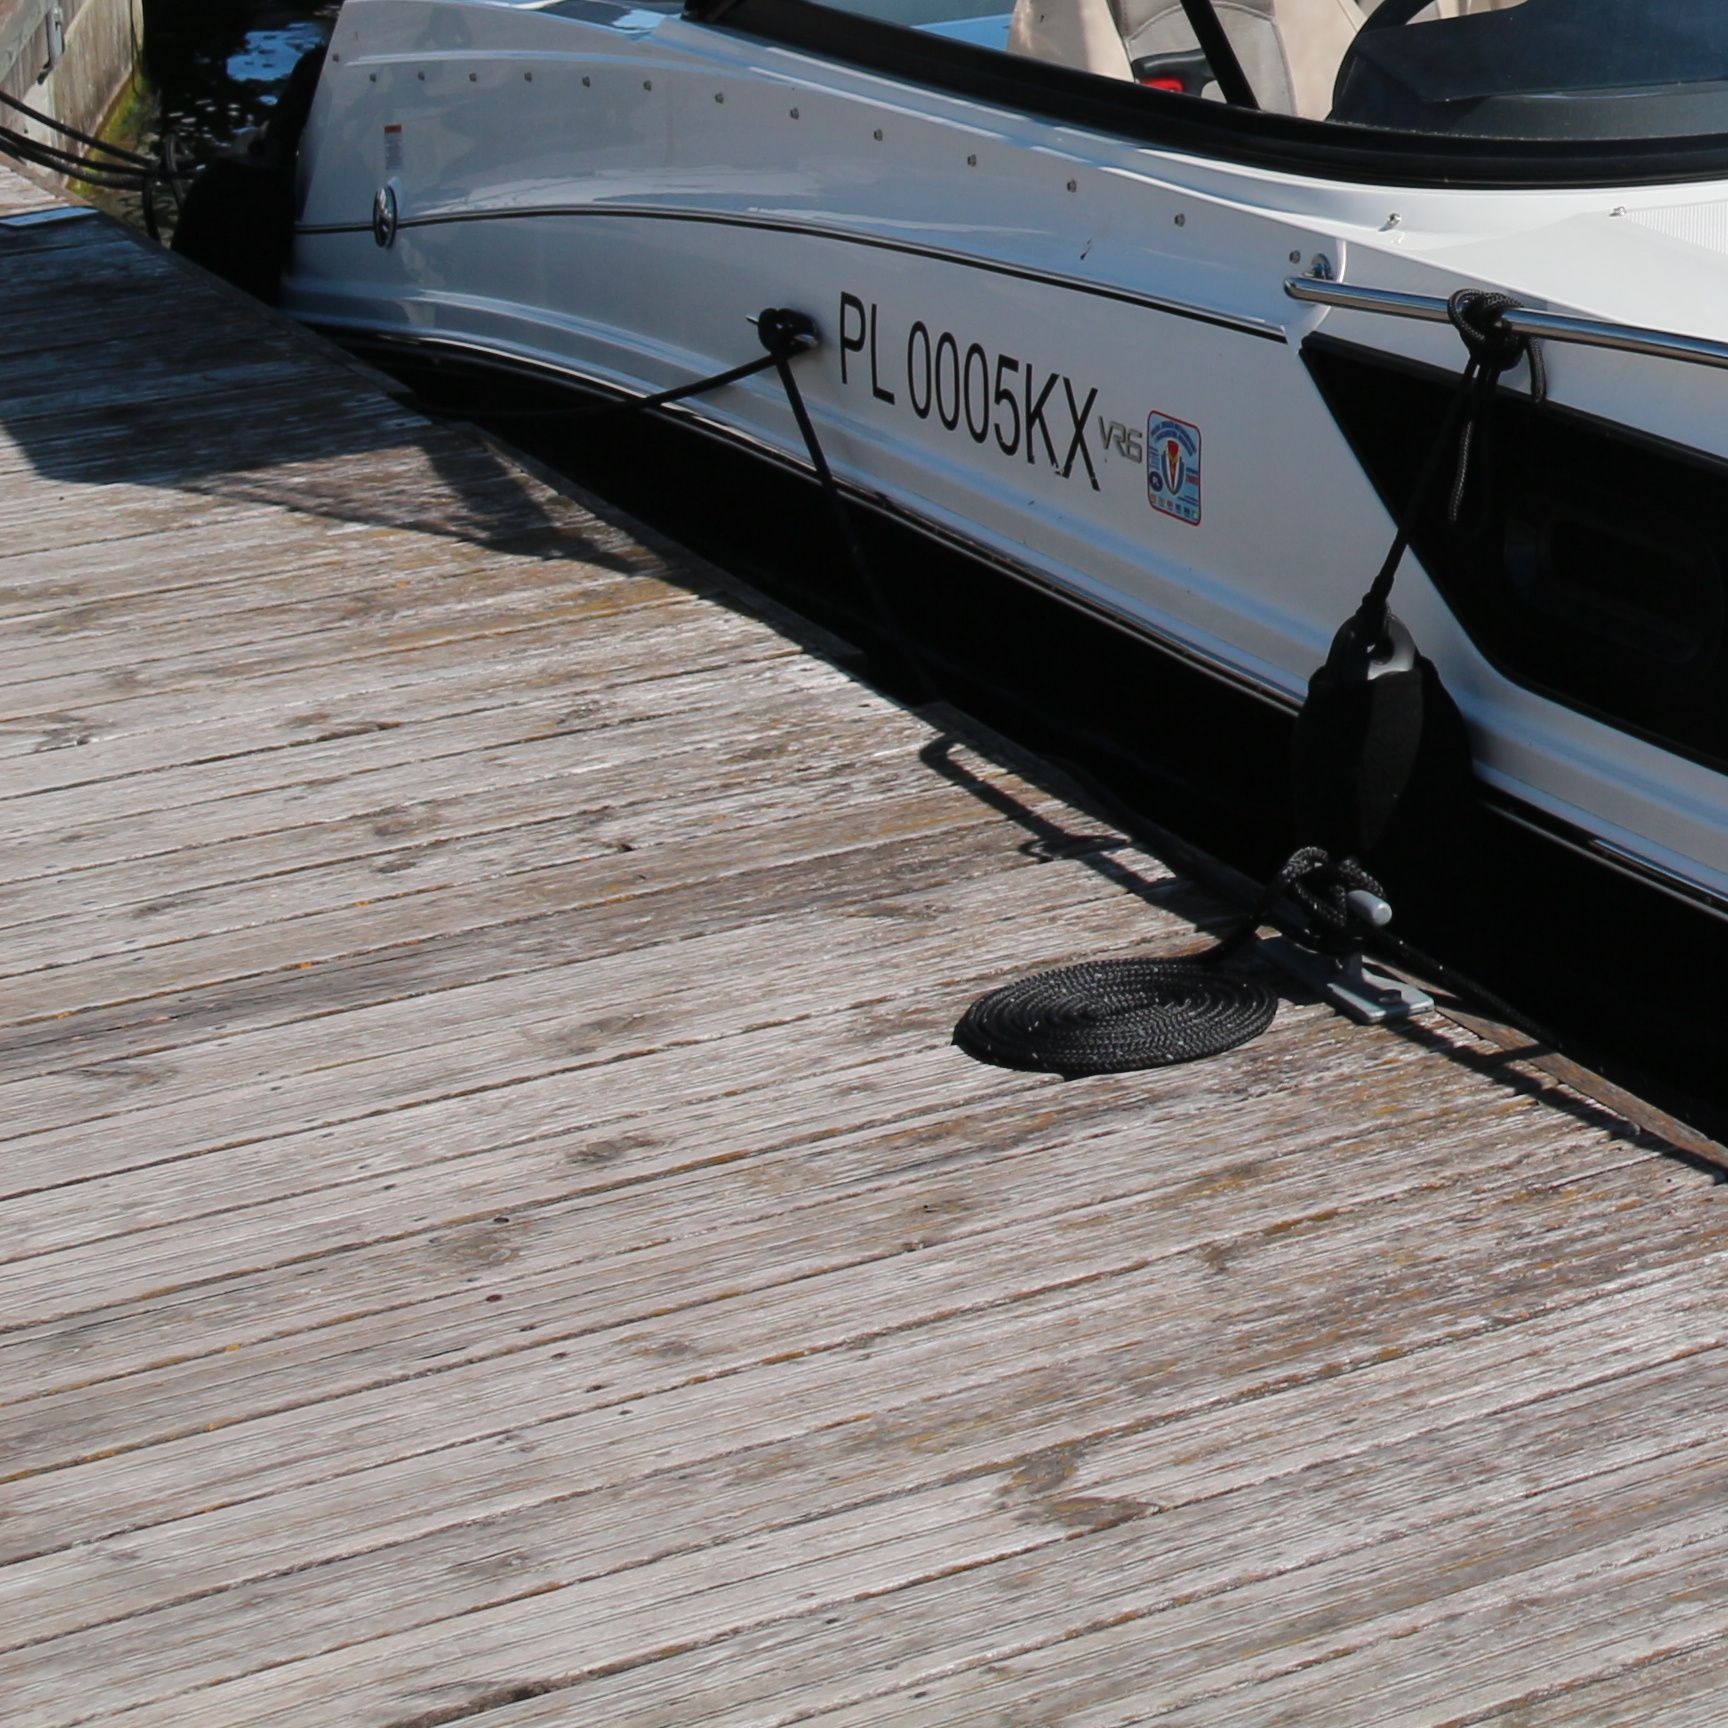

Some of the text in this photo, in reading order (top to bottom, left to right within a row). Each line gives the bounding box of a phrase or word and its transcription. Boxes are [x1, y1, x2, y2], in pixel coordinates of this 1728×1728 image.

[839, 291, 1101, 492] PL 0005KX
[1098, 415, 1143, 464] VR6
